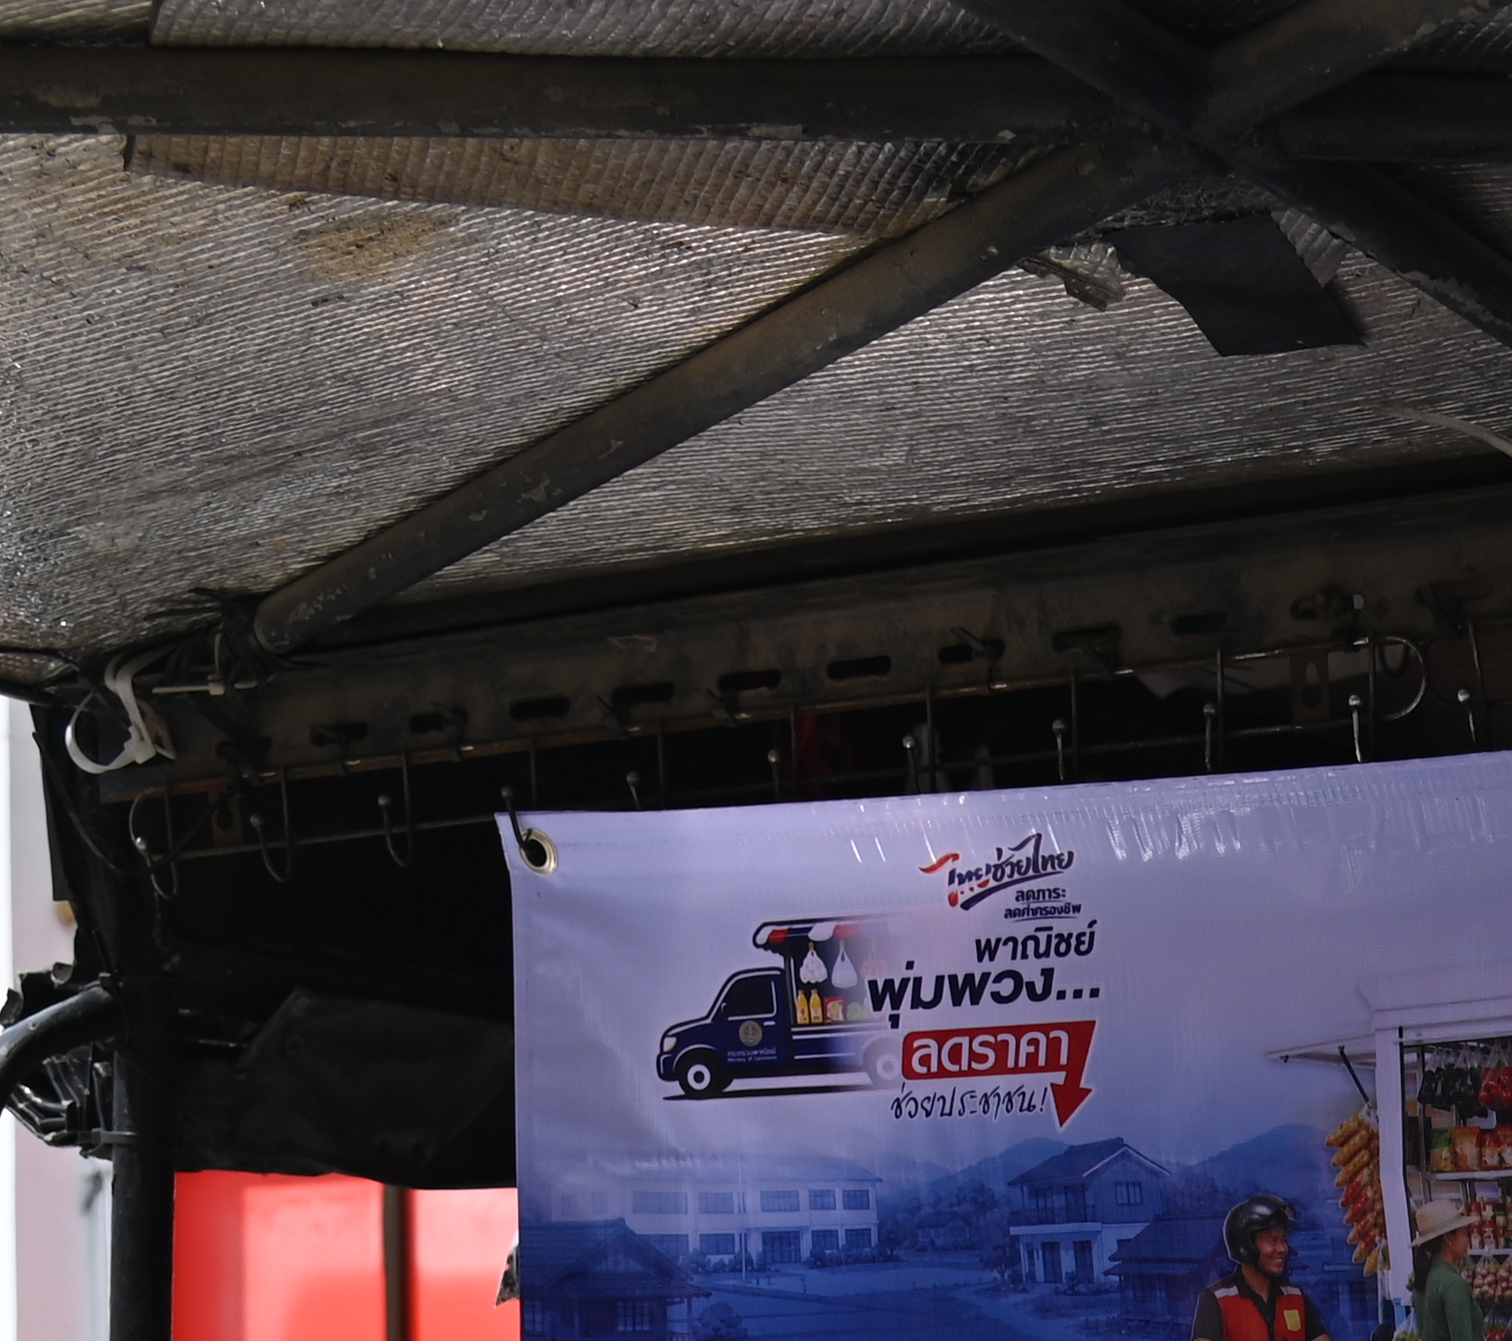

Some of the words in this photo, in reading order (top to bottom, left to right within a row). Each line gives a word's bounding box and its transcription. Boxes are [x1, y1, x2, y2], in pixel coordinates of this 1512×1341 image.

[1015, 887, 1067, 902] ลดภาระ
[974, 920, 1097, 963] พาณิชย์
[867, 960, 1101, 1029] พุ่มพวง...
[910, 1028, 1070, 1075] ลดราคา
[890, 1082, 1046, 1121] ช่วยประชาชน!
